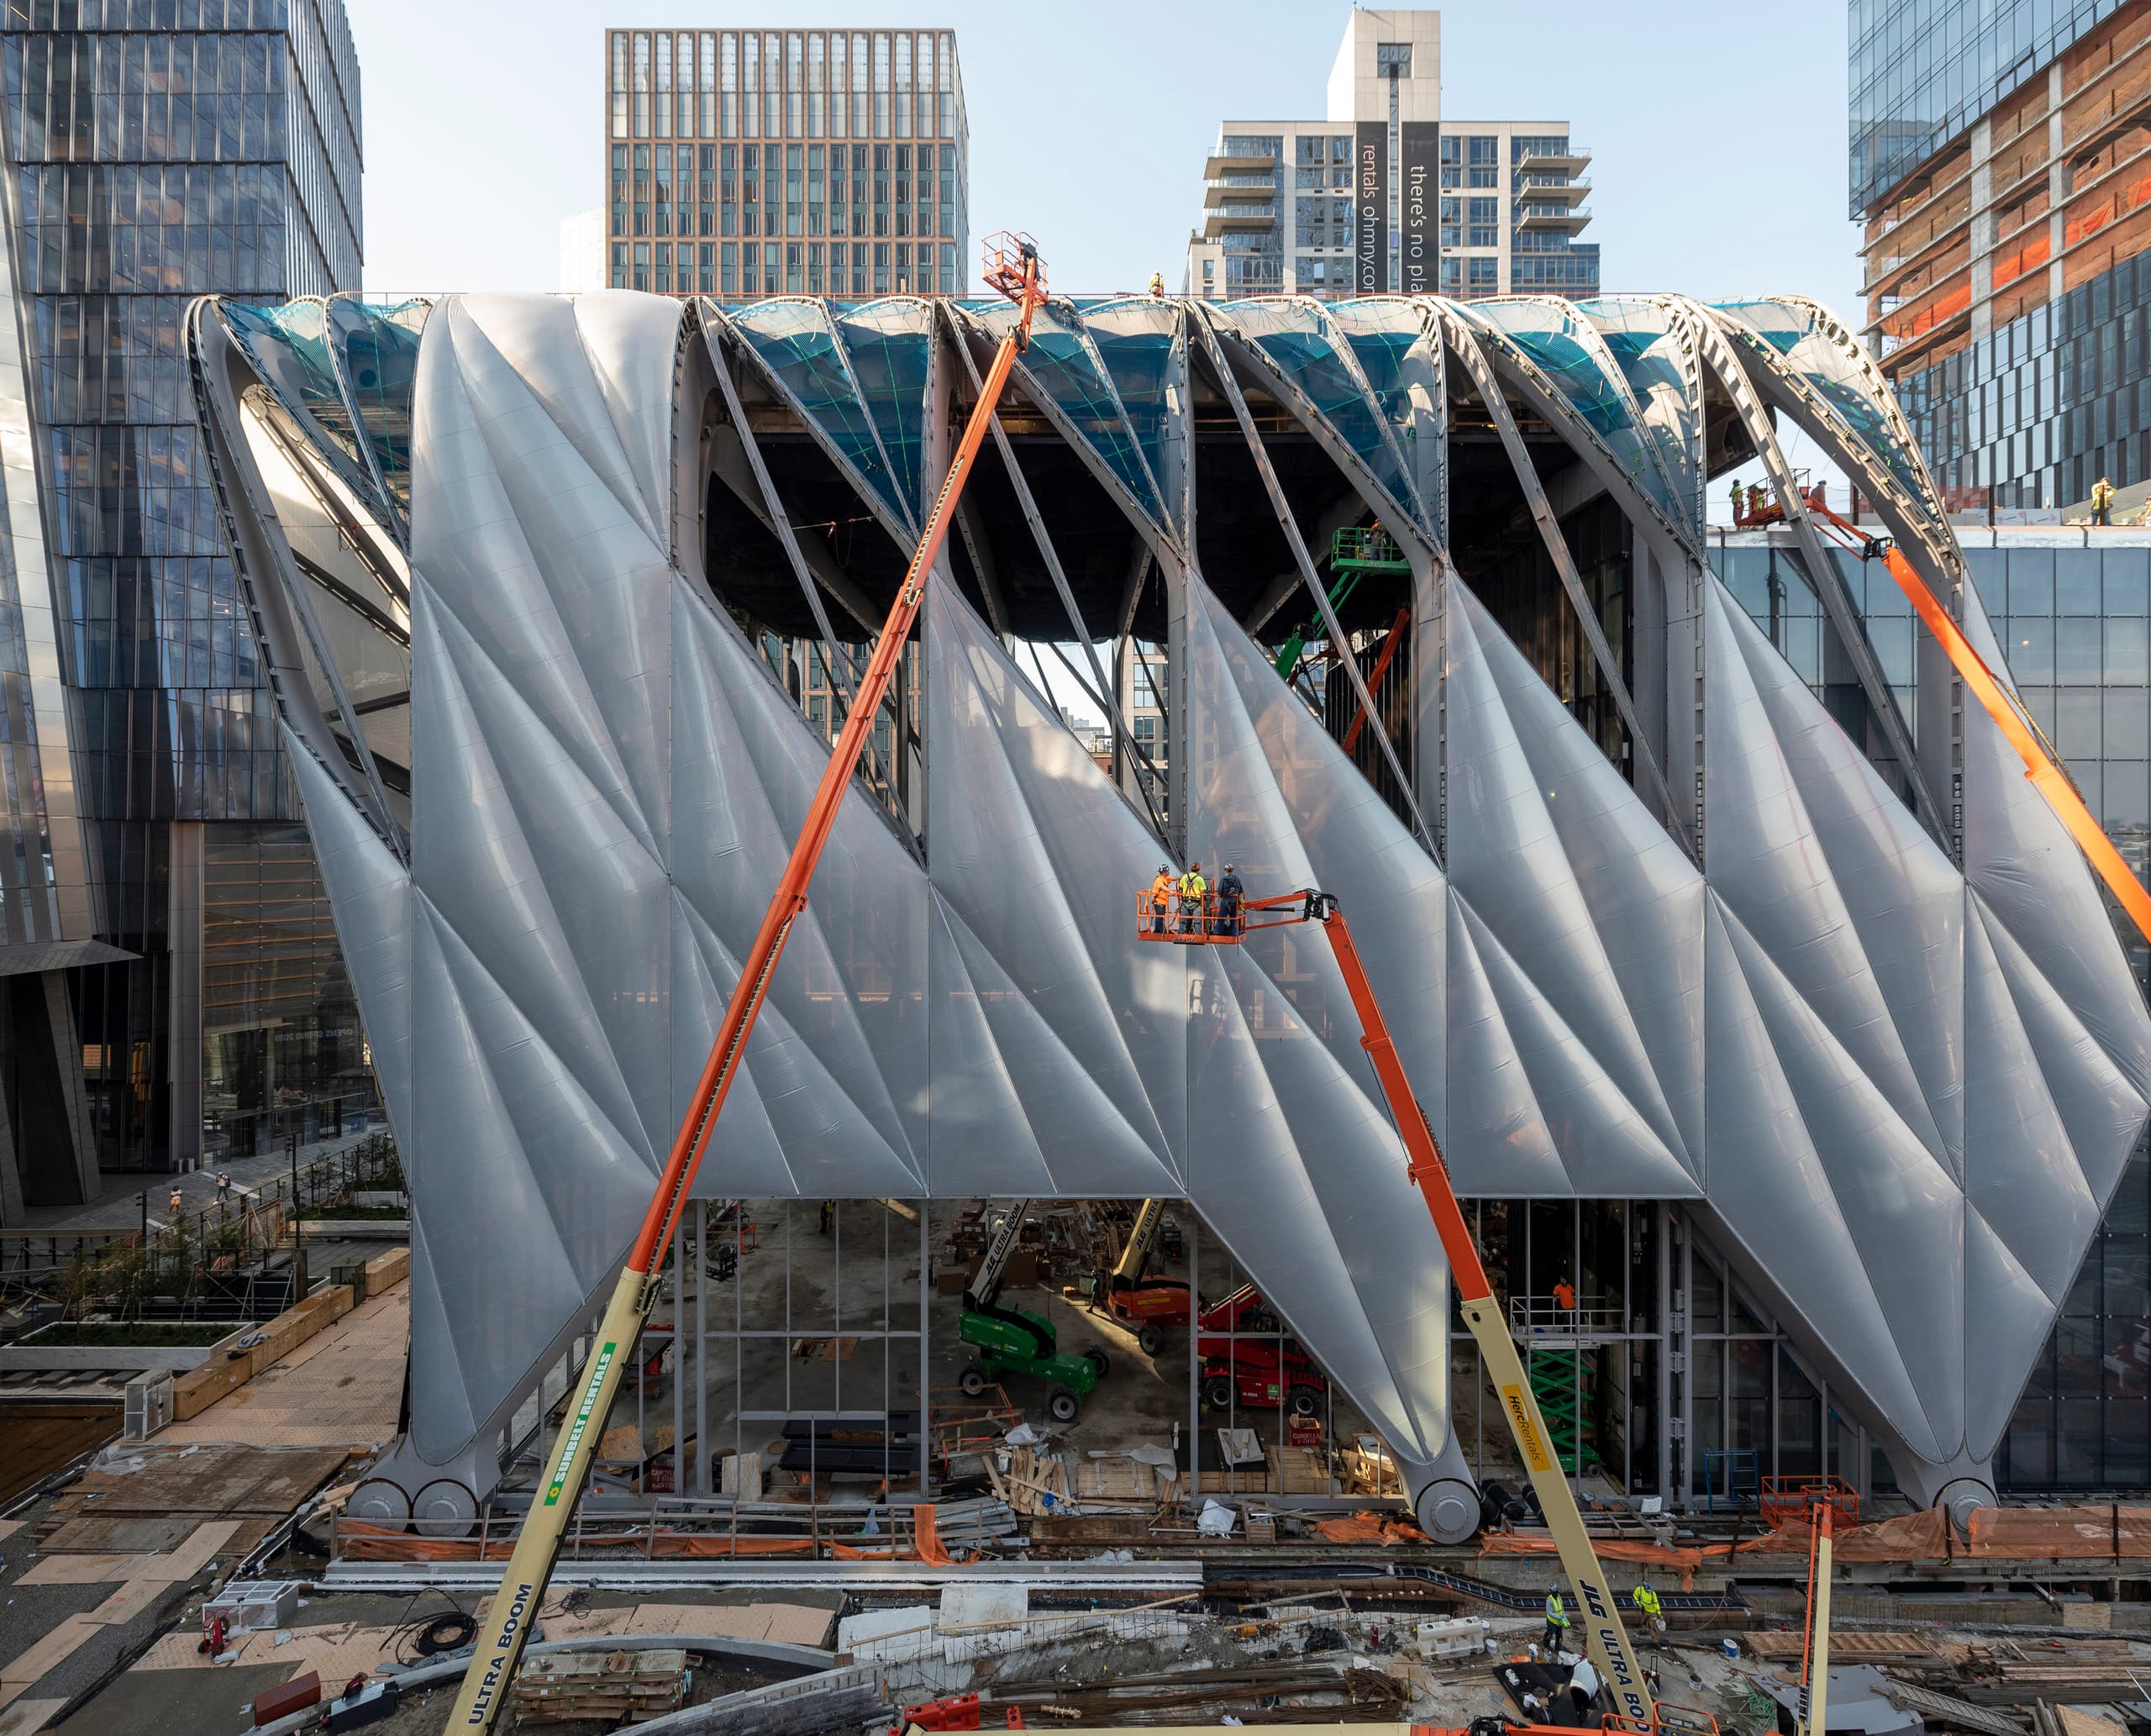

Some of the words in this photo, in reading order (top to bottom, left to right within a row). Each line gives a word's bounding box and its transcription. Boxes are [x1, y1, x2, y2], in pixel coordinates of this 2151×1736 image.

[1363, 145, 1380, 198] rentals
[1411, 165, 1428, 227] there's
[1411, 234, 1423, 258] no
[986, 1255, 1000, 1276] JLG
[993, 1230, 1010, 1255] ULTRA
[1008, 1203, 1023, 1229] BOOM
[1136, 1230, 1148, 1250] JLG
[1144, 1201, 1160, 1227] ULTRA
[555, 1418, 586, 1482] SUNBELT
[580, 1354, 612, 1416] RENTALS
[1509, 1396, 1540, 1460] HercRentals
[468, 1655, 507, 1725] ULTRA
[497, 1583, 534, 1649] BOOM
[1579, 1579, 1608, 1620] JLG
[1599, 1628, 1633, 1686] ULTRA
